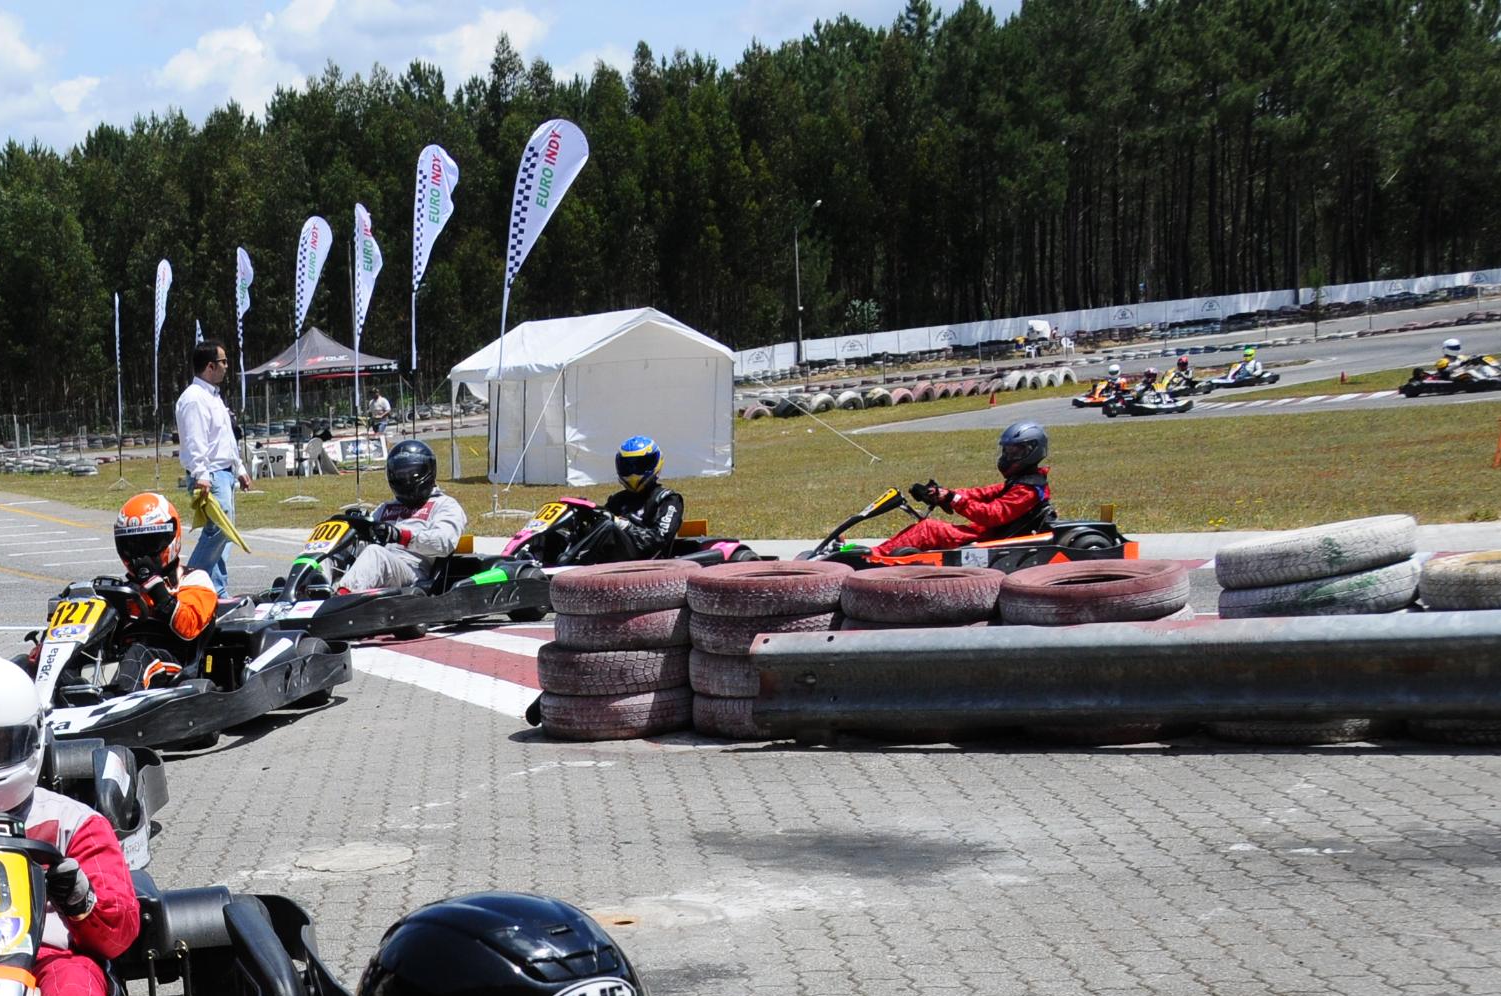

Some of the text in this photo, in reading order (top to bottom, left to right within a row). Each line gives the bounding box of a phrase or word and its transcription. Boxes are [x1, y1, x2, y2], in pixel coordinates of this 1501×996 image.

[428, 154, 443, 224] EURO INDY
[535, 130, 563, 209] EURO INDY
[307, 224, 320, 281] EURO INDY
[363, 239, 374, 273] EURO
[309, 523, 342, 541] 100
[52, 601, 96, 628] 127
